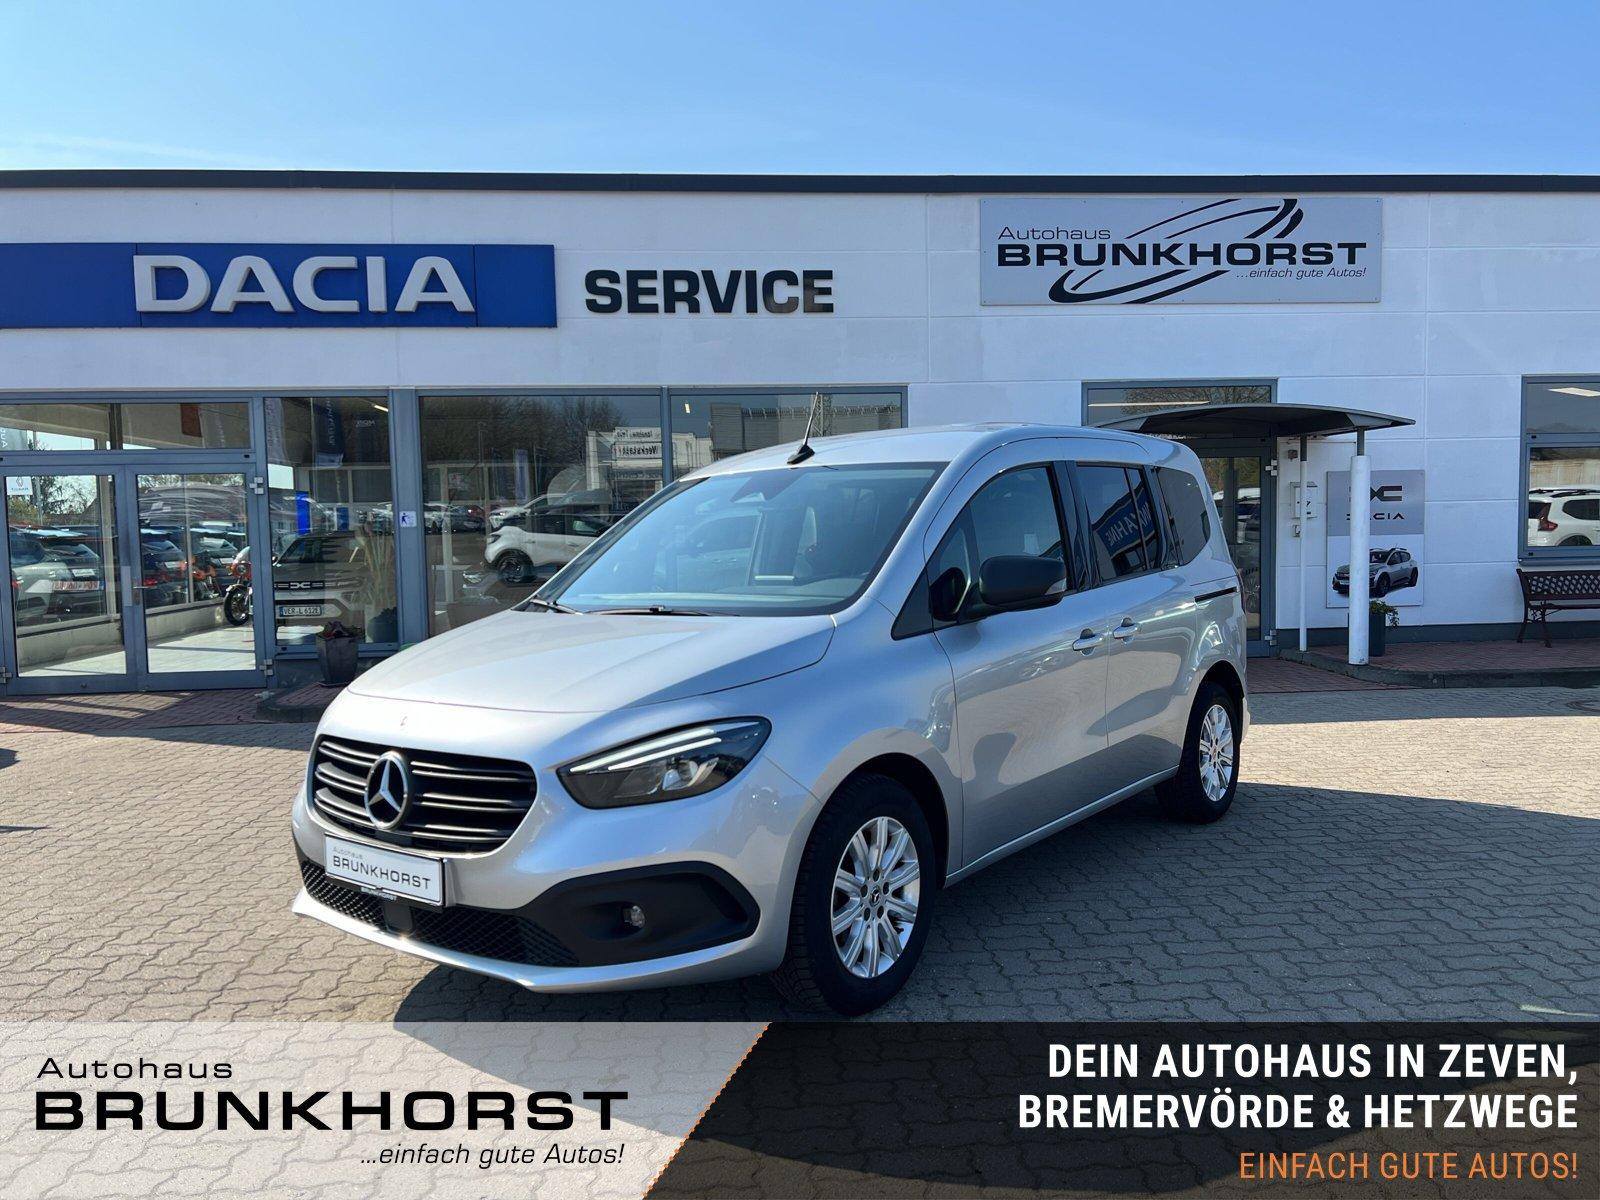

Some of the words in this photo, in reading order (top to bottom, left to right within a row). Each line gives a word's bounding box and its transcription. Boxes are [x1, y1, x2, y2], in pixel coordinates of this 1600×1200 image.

[998, 226, 1111, 241] Autohaus
[997, 242, 1367, 267] BRUNKHORST
[133, 255, 475, 313] DACIA
[1296, 269, 1324, 281] gute
[1327, 267, 1367, 279] Autos!
[585, 269, 835, 314] SERVICE
[1346, 512, 1405, 520] CIA
[333, 856, 431, 889] BRUNKHORST
